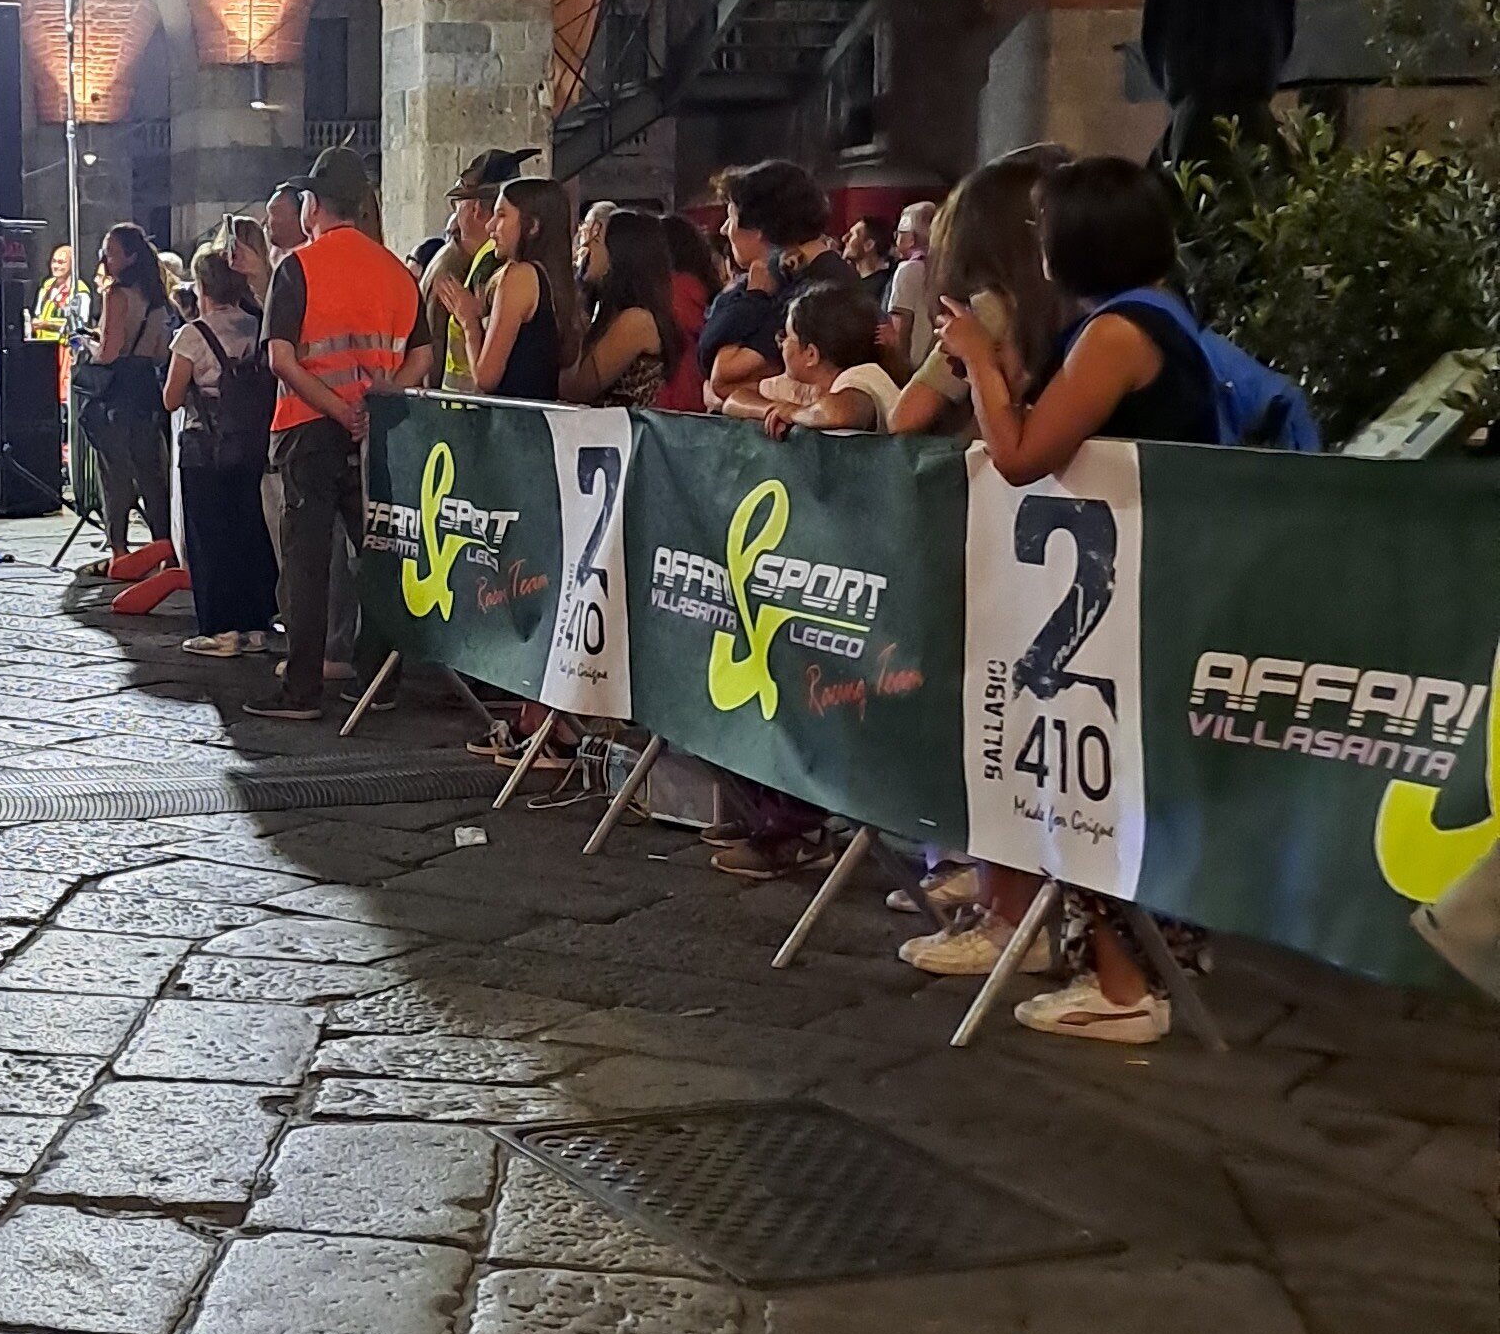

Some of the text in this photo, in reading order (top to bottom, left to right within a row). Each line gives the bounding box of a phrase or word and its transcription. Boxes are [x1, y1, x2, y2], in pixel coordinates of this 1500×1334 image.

[651, 587, 865, 659] VILLASANTA LECCO
[750, 553, 888, 620] SPORT
[1013, 494, 1118, 723] 2
[984, 659, 1007, 781] BALLABIO
[1189, 651, 1488, 746] AFFARI
[1015, 715, 1112, 801] 410
[1188, 711, 1457, 780] VILLASANTA
